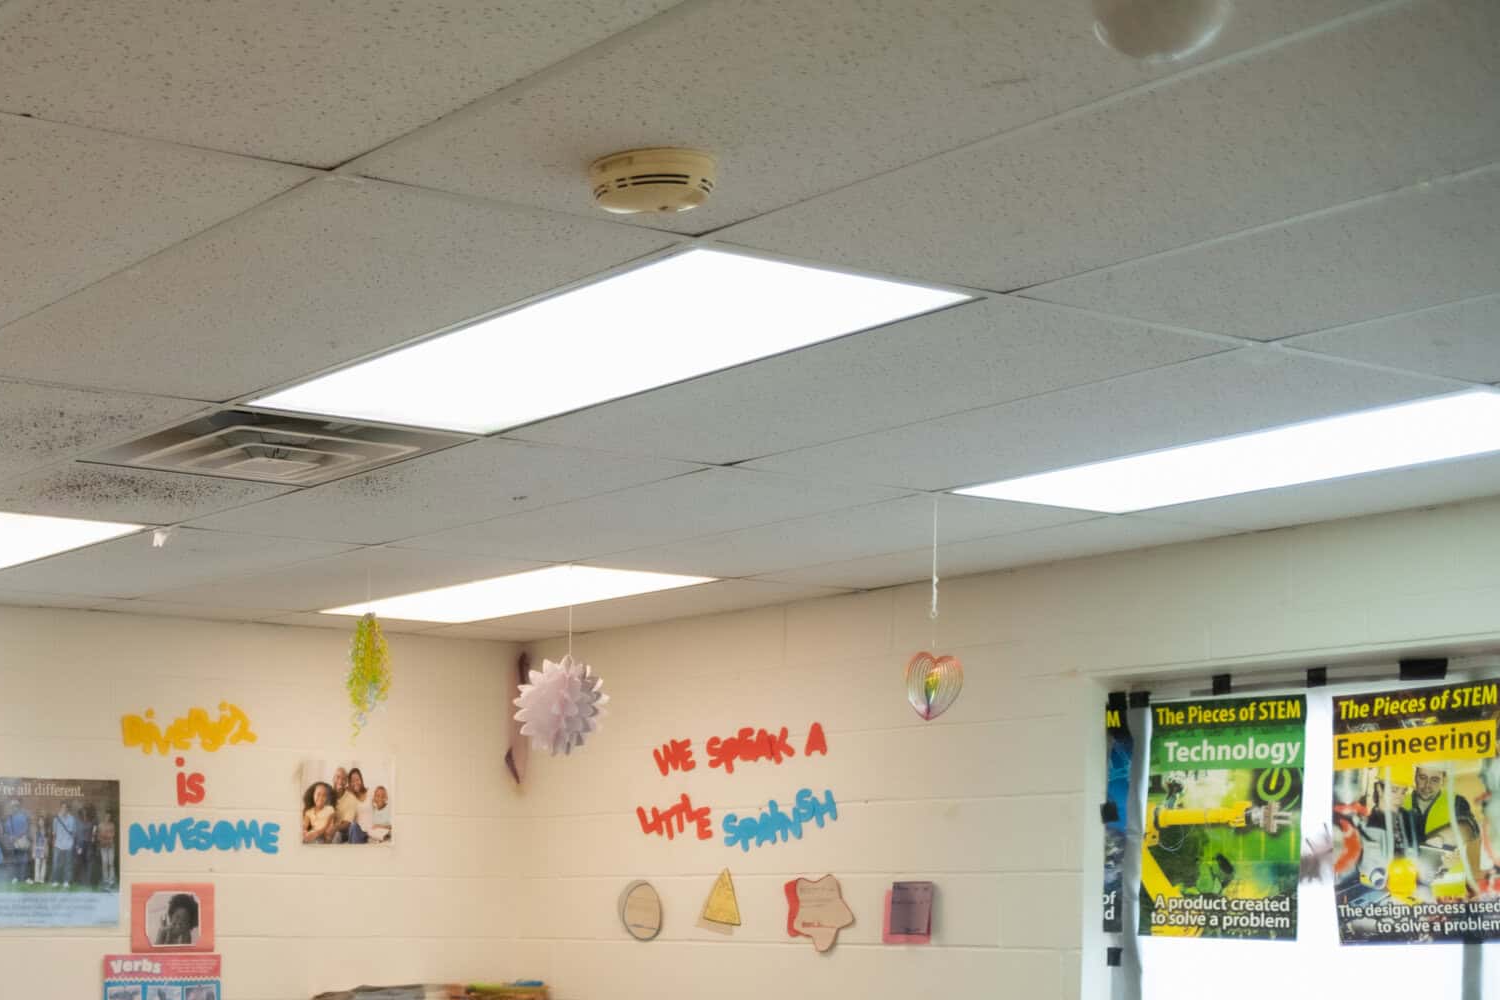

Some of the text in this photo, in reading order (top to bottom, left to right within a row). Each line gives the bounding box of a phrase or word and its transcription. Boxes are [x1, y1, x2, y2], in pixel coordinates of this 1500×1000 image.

[1156, 699, 1301, 726] The Pieces of STEM
[1340, 685, 1498, 720] The Pieces of STEM
[653, 722, 827, 776] WE SPEAK A
[1164, 737, 1301, 765] Technology
[1337, 727, 1492, 762] Engineering
[17, 783, 32, 796] all
[34, 783, 85, 797] different.
[175, 757, 206, 806] is
[636, 794, 713, 841] LITTLE
[128, 817, 280, 855] AWESOME
[1155, 895, 1290, 915] A product created
[1339, 900, 1500, 921] The design process used
[1152, 911, 1290, 930] to solve a problem
[1377, 920, 1391, 932] to
[1394, 918, 1431, 933] solve
[1433, 922, 1441, 931] a
[109, 959, 162, 975] Verbs
